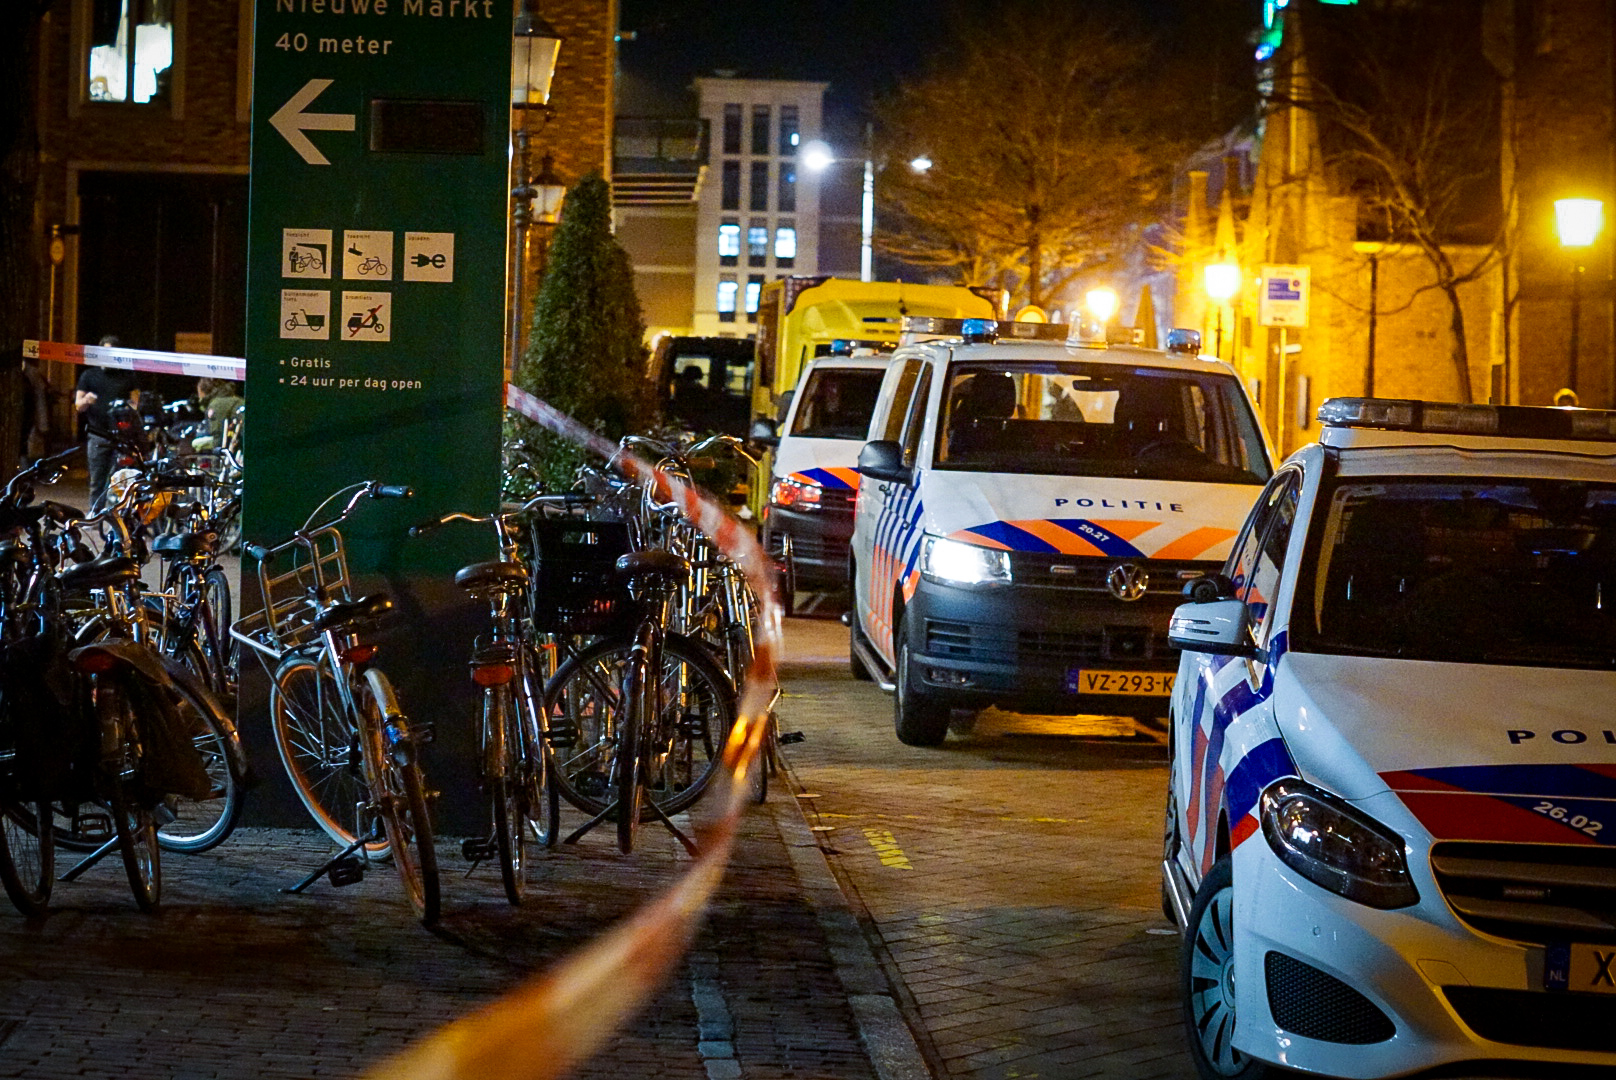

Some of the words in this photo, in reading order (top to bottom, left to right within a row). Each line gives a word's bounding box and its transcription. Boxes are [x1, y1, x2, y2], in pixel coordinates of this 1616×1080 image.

[276, 0, 388, 15] Nieuwe
[403, 0, 493, 18] Markt
[275, 32, 308, 52] 40
[319, 35, 393, 55] meter
[290, 356, 331, 369] Gratis
[290, 375, 307, 386] 24
[312, 377, 335, 387] uur
[339, 378, 360, 389] per
[364, 377, 387, 391] dag
[391, 380, 422, 391] open
[1055, 498, 1184, 512] POLITIE
[1078, 524, 1110, 542] 20.27
[1507, 729, 1616, 745] POL
[1532, 801, 1604, 837] 26.02
[1549, 969, 1567, 982] NL
[1590, 951, 1616, 988] X
